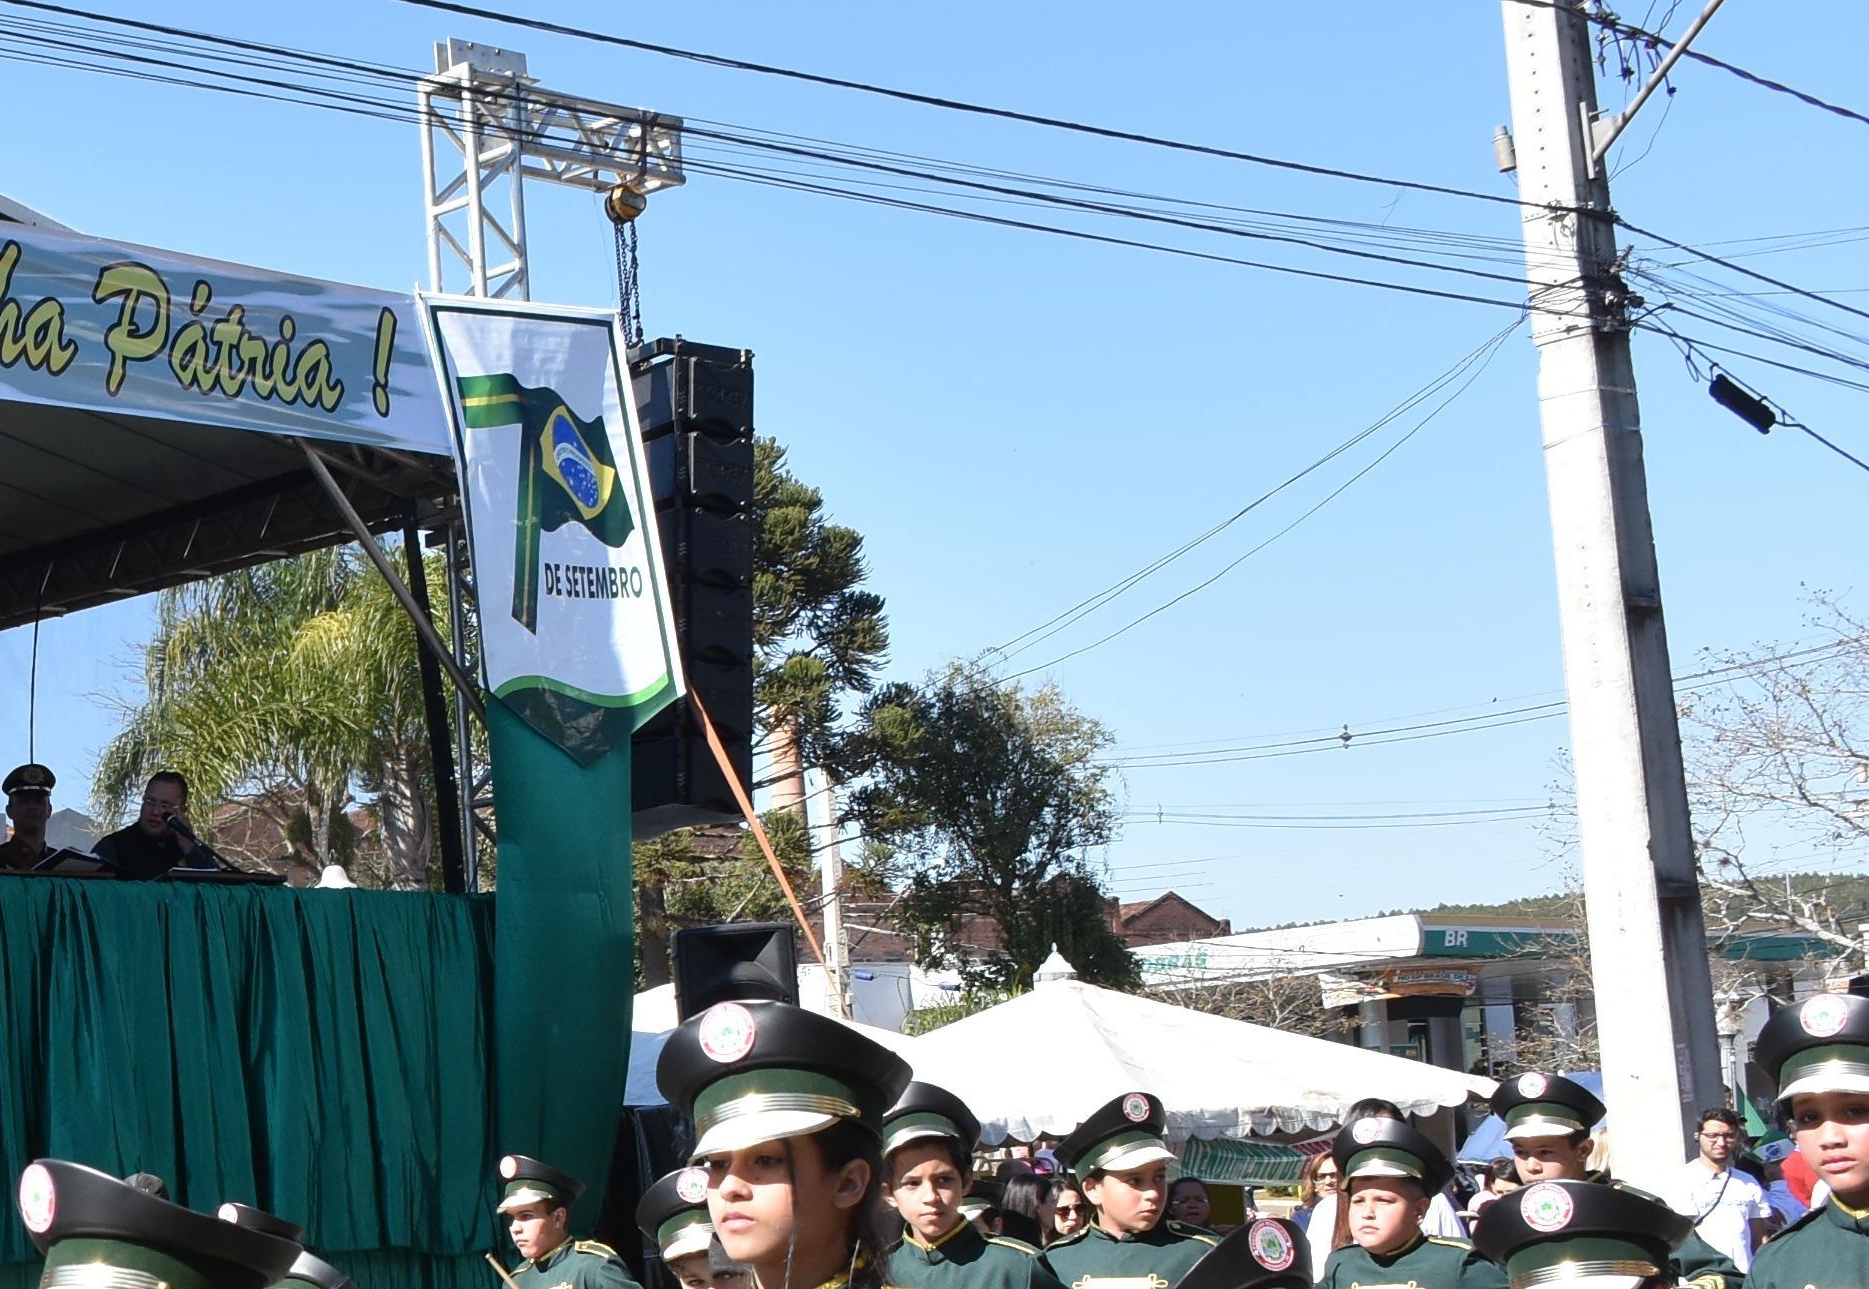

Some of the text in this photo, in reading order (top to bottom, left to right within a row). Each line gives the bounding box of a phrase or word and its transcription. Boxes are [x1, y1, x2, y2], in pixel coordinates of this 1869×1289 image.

[94, 261, 344, 415] Pátria
[544, 563, 643, 599] DE SETEMBRO
[1444, 930, 1468, 947] BR
